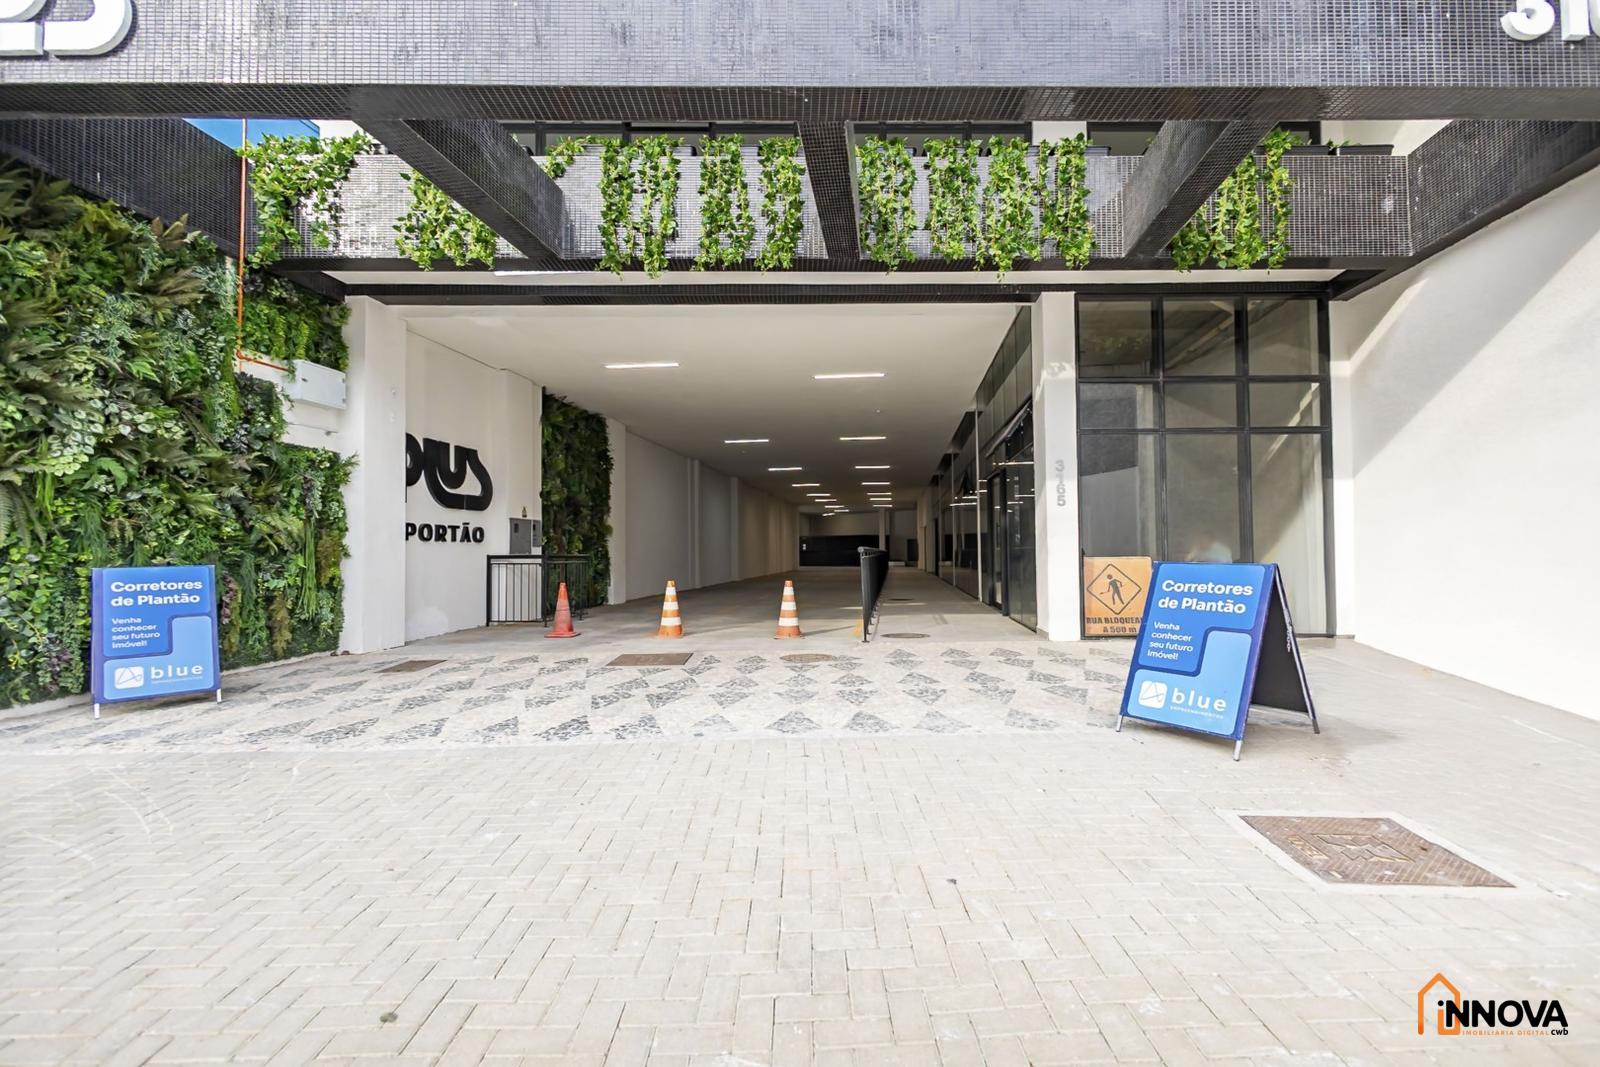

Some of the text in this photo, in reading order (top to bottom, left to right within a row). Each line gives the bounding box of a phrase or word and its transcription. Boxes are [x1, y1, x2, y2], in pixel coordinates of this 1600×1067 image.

[406, 522, 485, 543] PORTÃO
[110, 580, 203, 593] Corretores
[1161, 579, 1254, 596] Corretores
[110, 593, 201, 607] de Plantão
[1158, 597, 1247, 614] de Plantão
[111, 624, 158, 633] conhecer
[1153, 621, 1180, 631] Venha
[1151, 632, 1193, 642] conhecer
[1149, 641, 1194, 652] seu futuro
[150, 665, 204, 679] blue
[1171, 687, 1227, 712] blue
